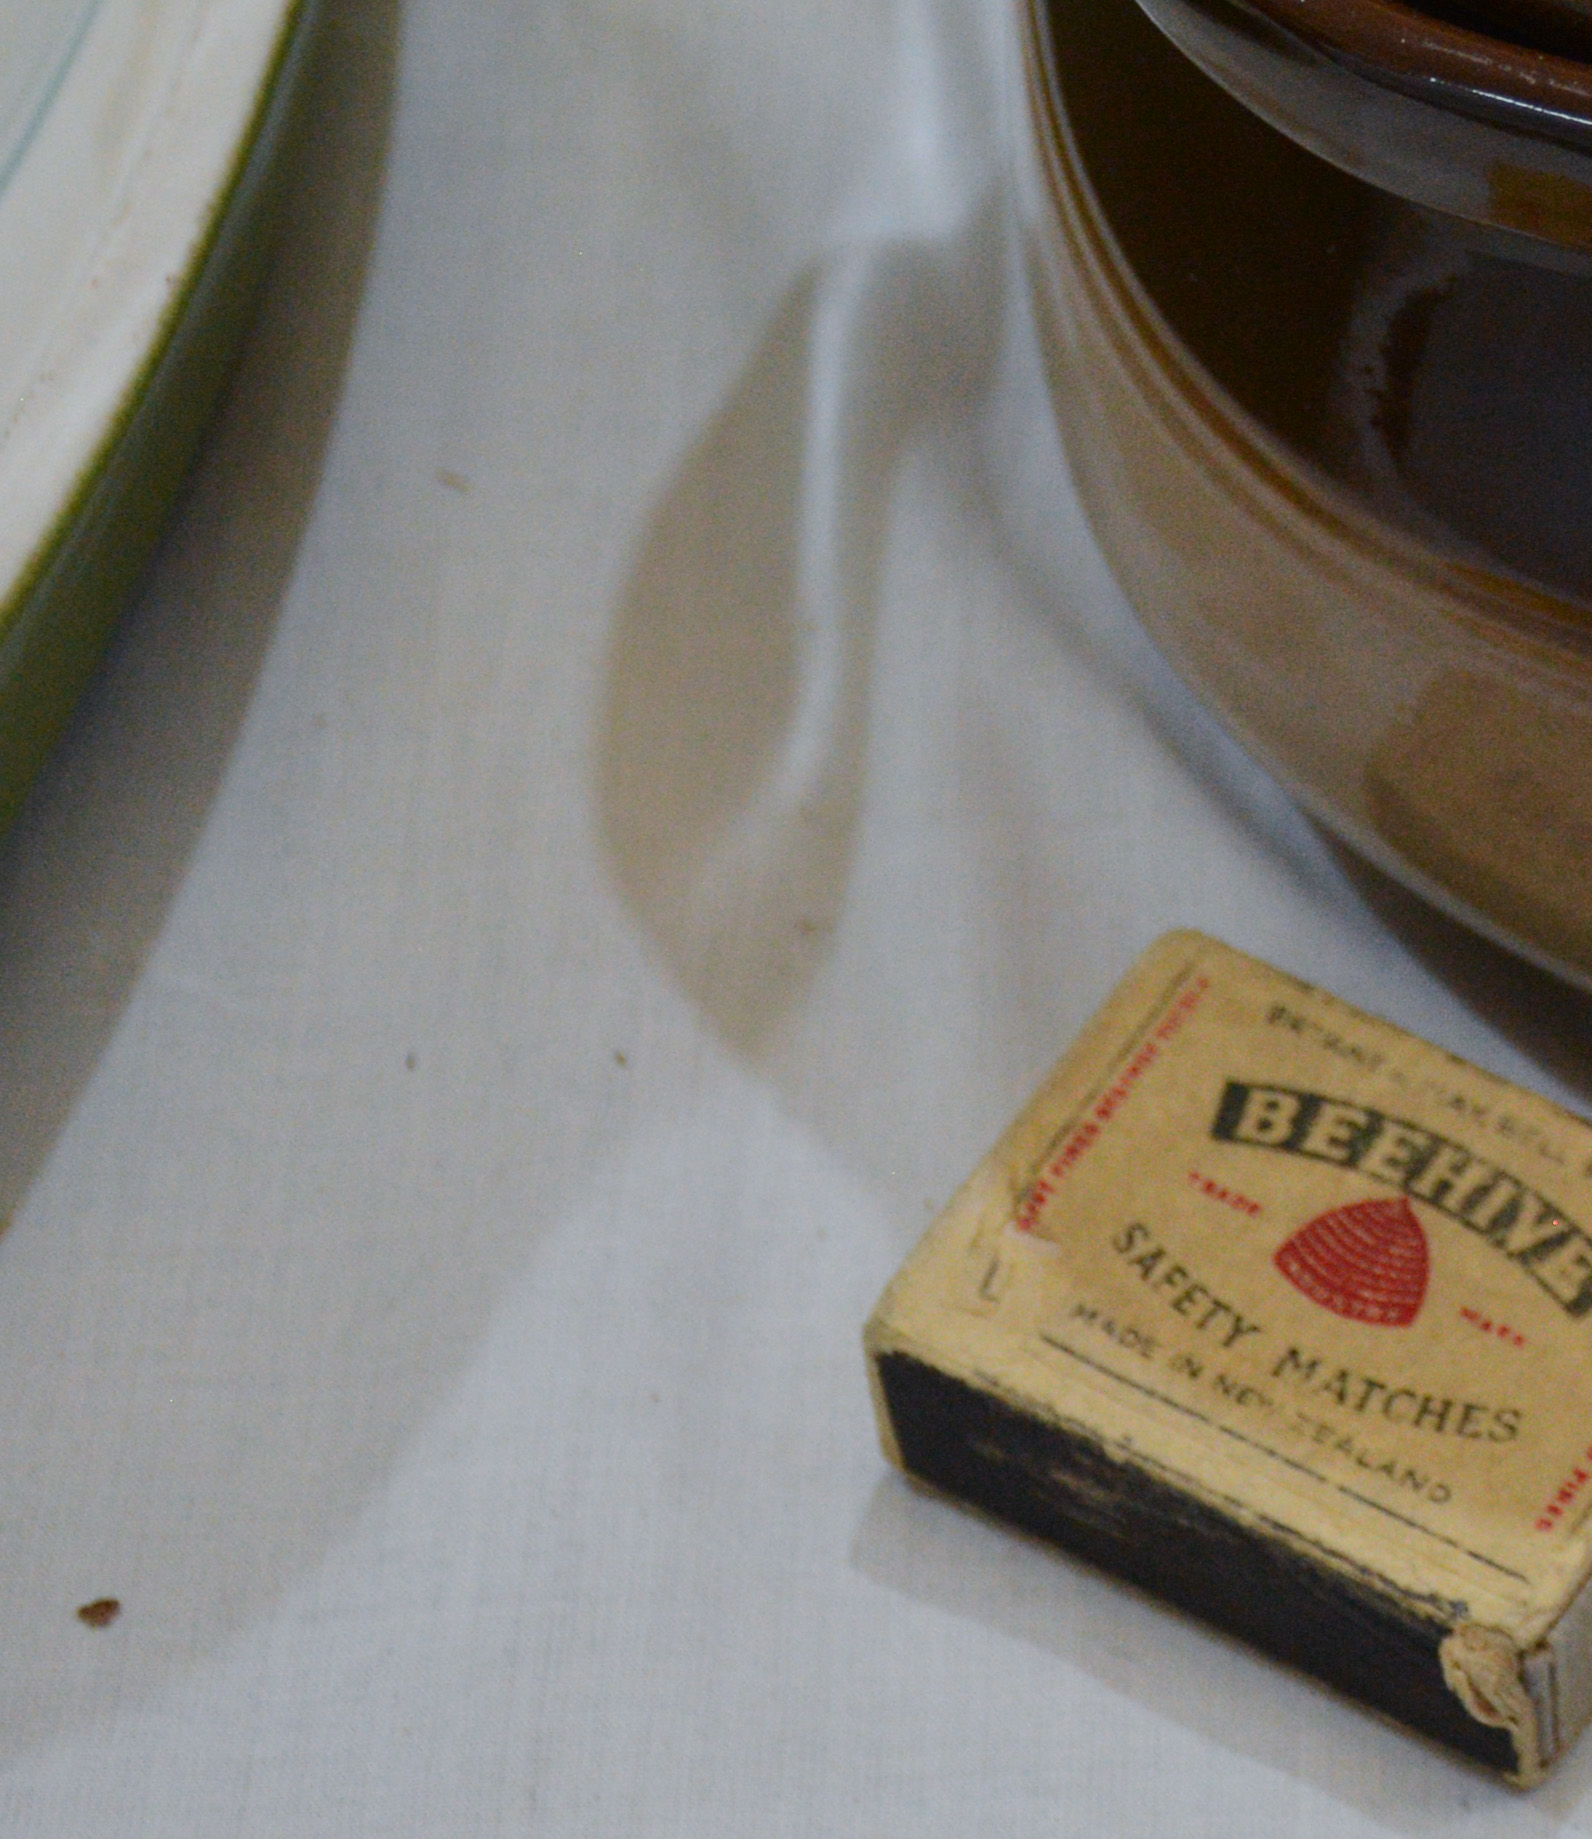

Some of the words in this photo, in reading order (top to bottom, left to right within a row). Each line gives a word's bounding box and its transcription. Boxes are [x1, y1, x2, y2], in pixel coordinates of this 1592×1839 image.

[1069, 1303, 1162, 1361] MADE
[1112, 1222, 1261, 1350] SAFETY
[1271, 1347, 1524, 1444] MATCHES
[1534, 1466, 1592, 1533] FIRES
